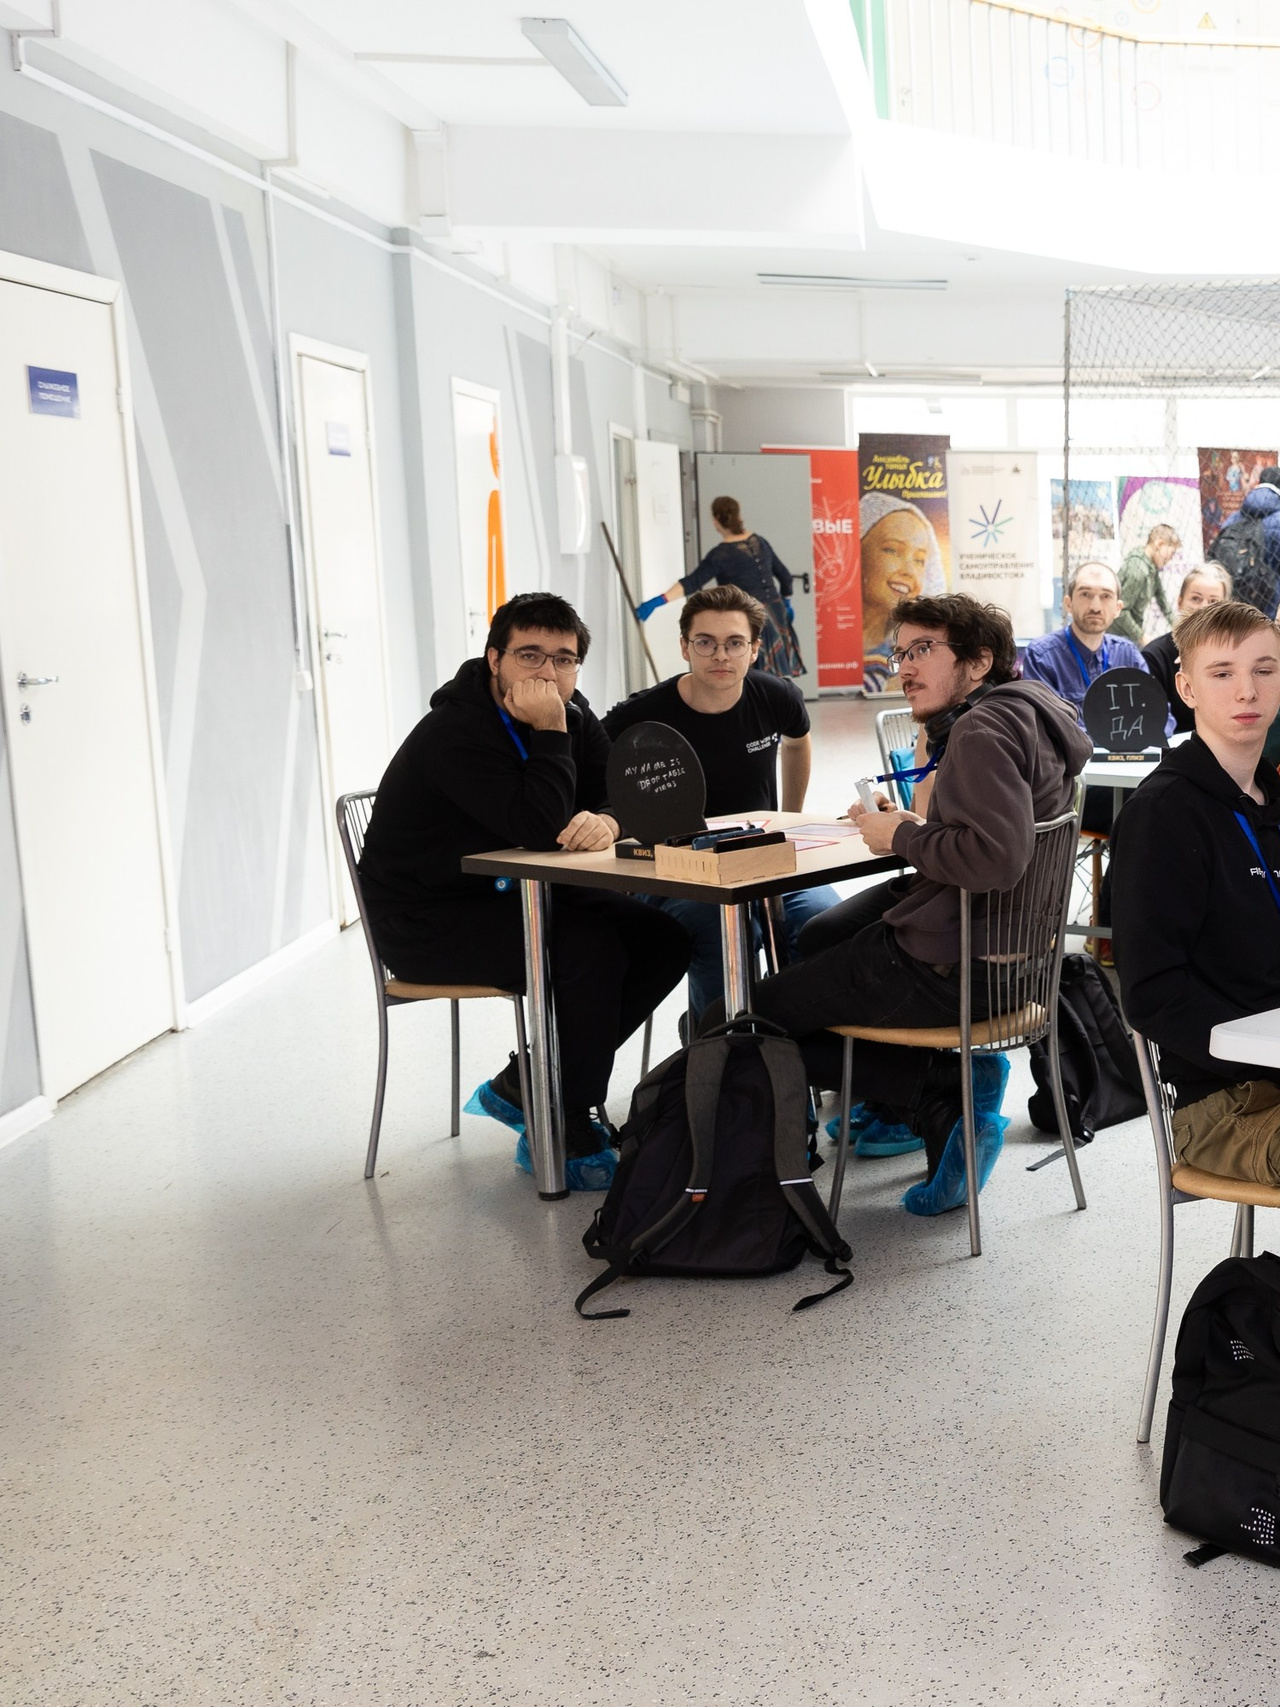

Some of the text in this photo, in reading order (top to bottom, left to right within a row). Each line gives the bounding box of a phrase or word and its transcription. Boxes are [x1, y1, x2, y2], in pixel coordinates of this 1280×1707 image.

[862, 461, 945, 490] Улыбка
[1110, 715, 1143, 741] ДА
[624, 766, 637, 776] MY
